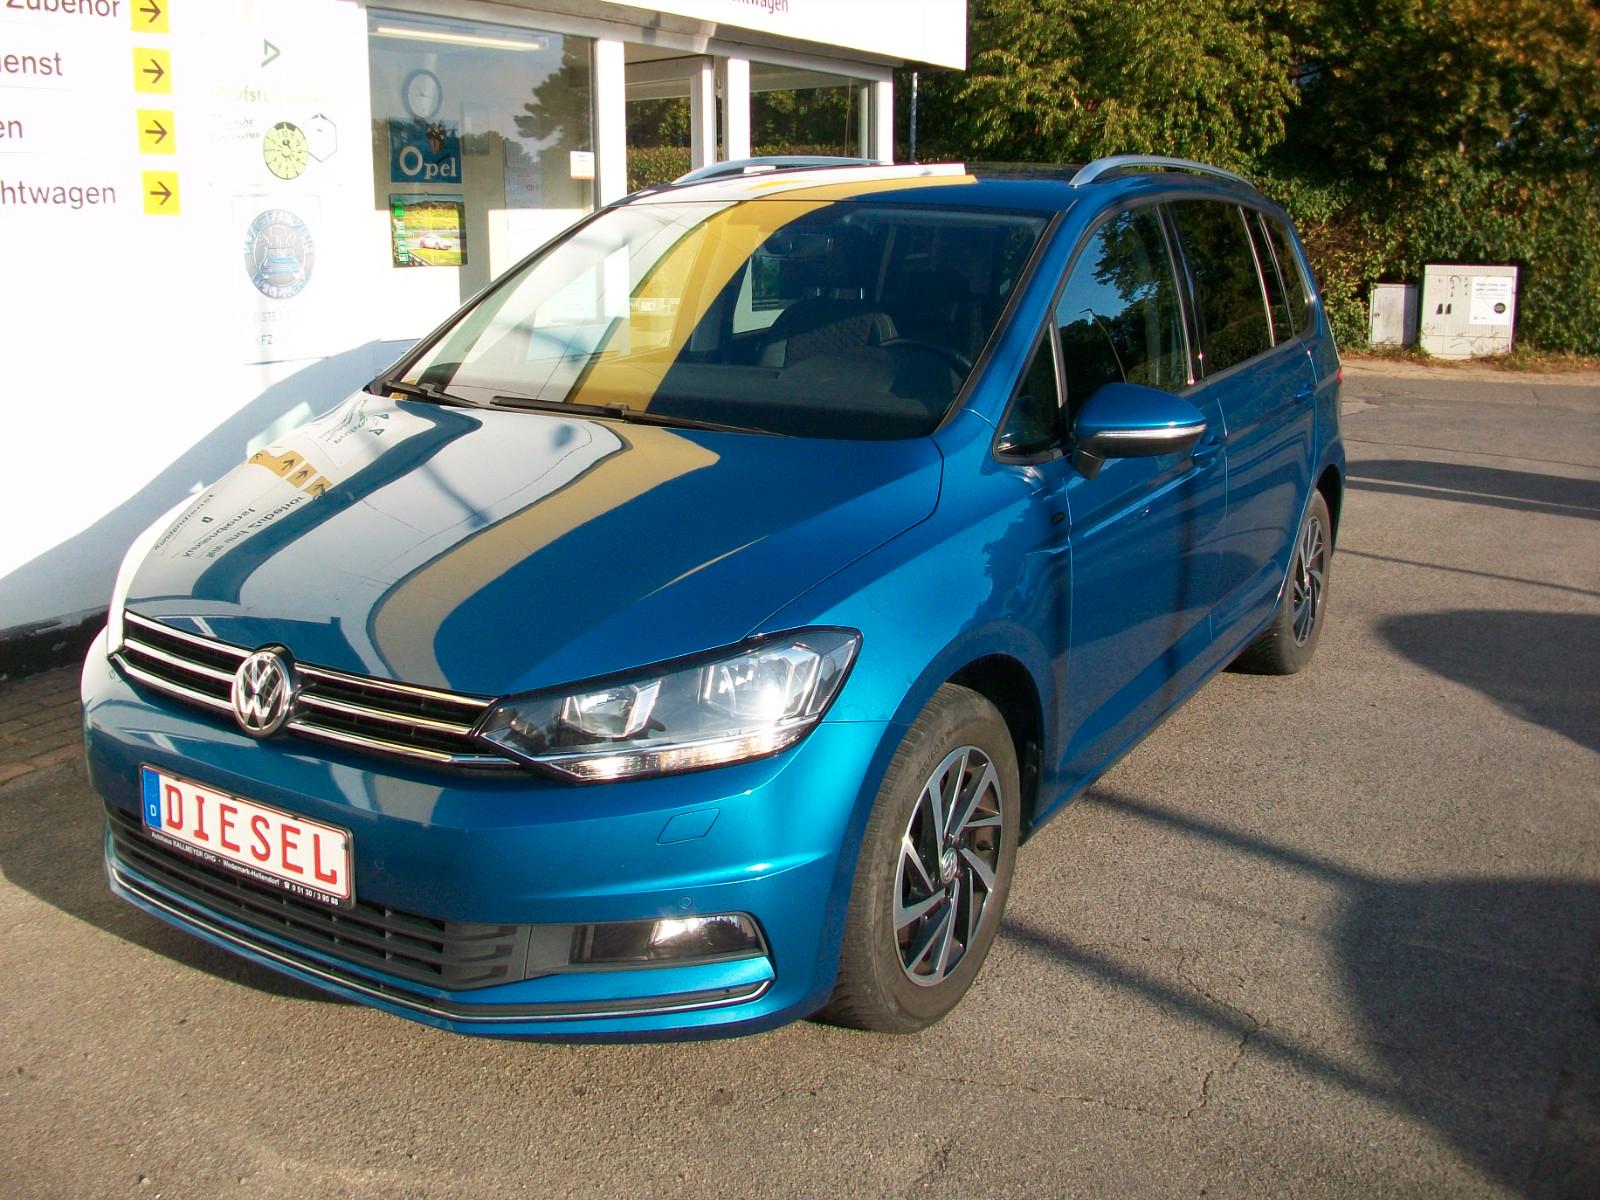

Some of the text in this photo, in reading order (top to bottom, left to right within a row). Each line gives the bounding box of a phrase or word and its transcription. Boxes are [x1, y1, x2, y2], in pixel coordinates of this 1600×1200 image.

[0, 52, 63, 76] enst
[399, 145, 457, 180] Opel
[164, 784, 338, 885] DIESEL
